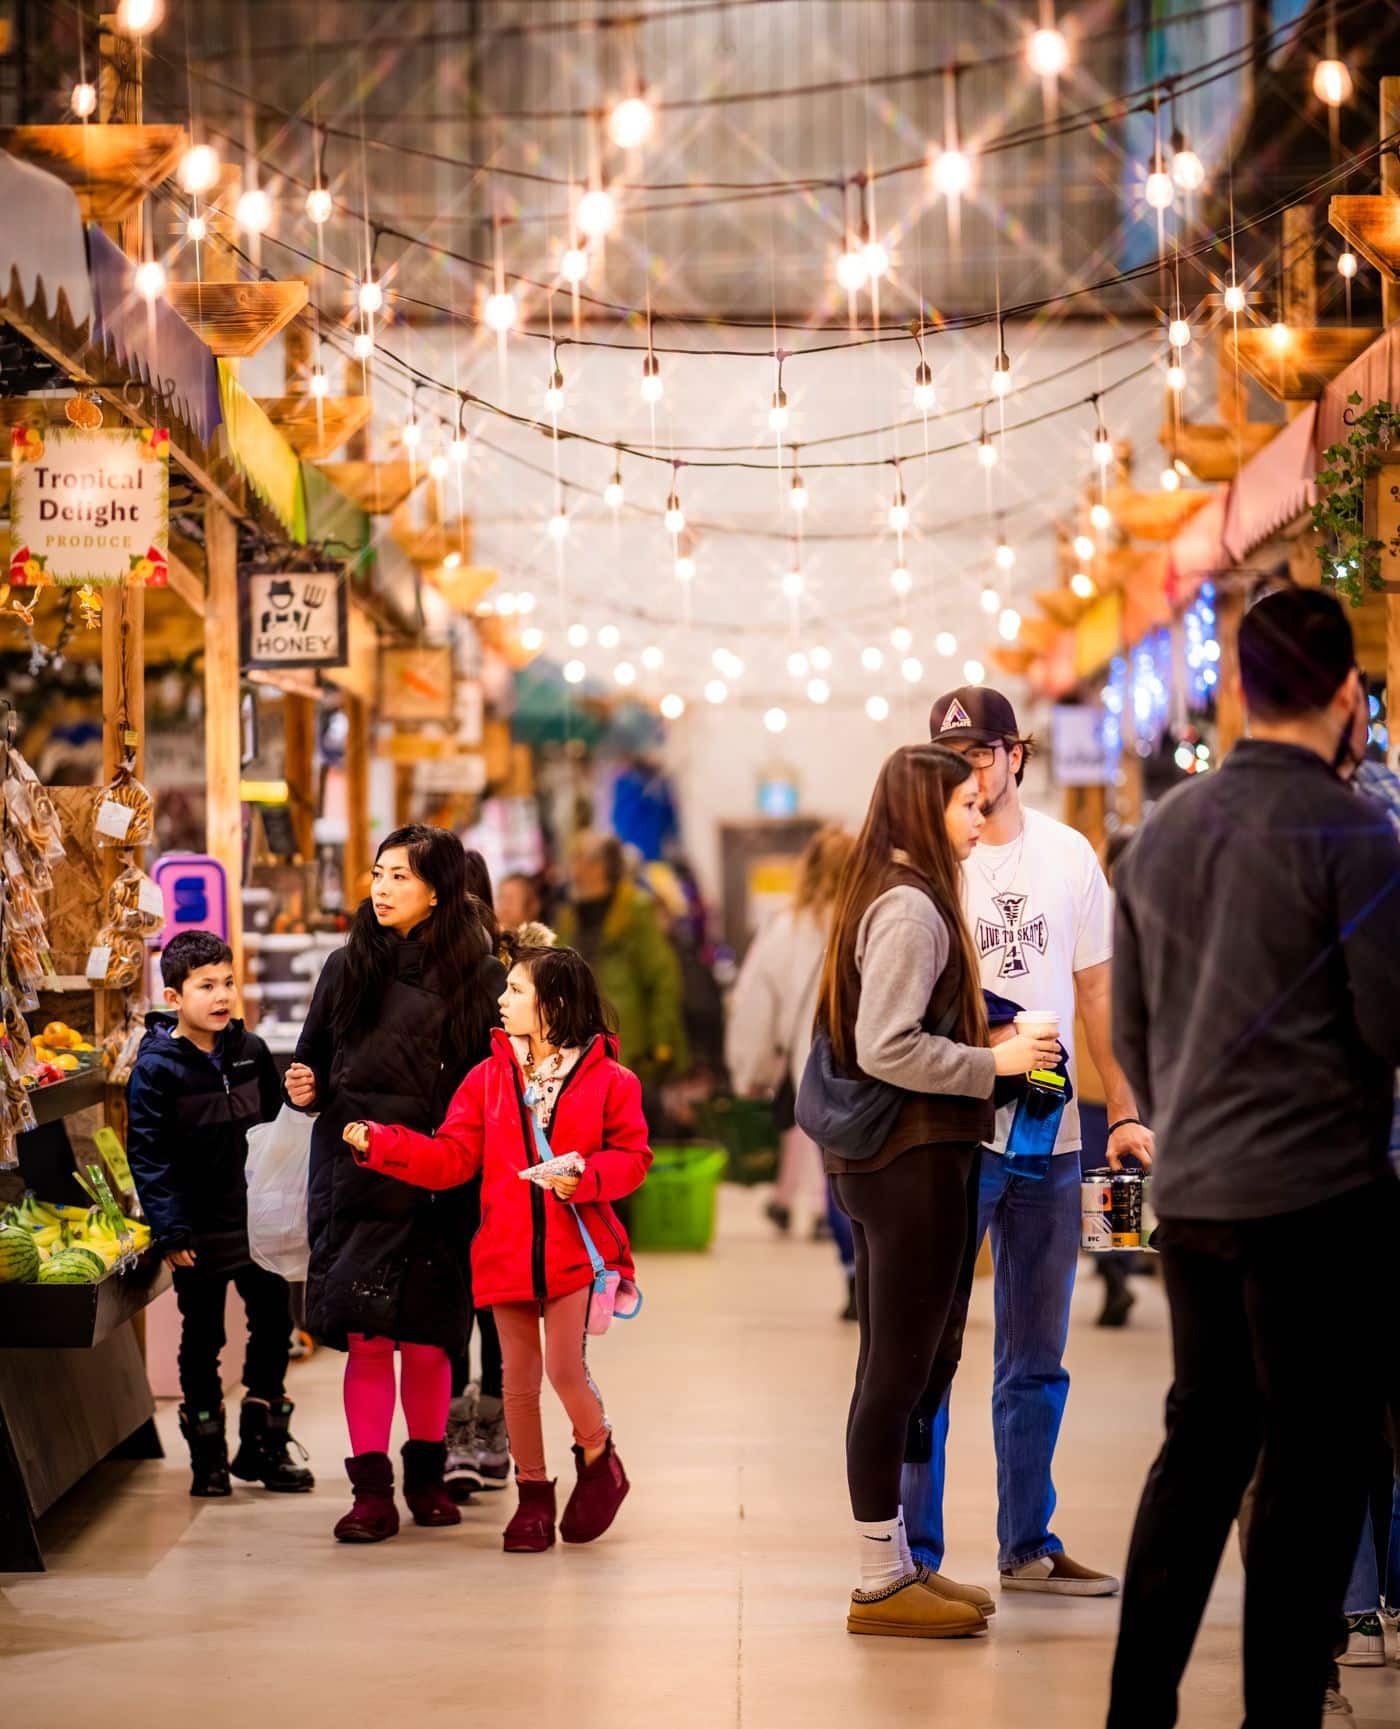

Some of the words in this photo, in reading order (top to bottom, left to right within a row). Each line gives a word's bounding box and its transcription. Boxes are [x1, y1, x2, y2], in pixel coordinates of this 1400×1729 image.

[34, 467, 143, 491] Tropical
[39, 500, 139, 528] Delight
[46, 535, 131, 548] PRODUCE
[256, 636, 332, 653] HONEY
[980, 924, 1000, 951] LIVE
[1001, 928, 1014, 944] TO
[1017, 920, 1043, 948] SKATE
